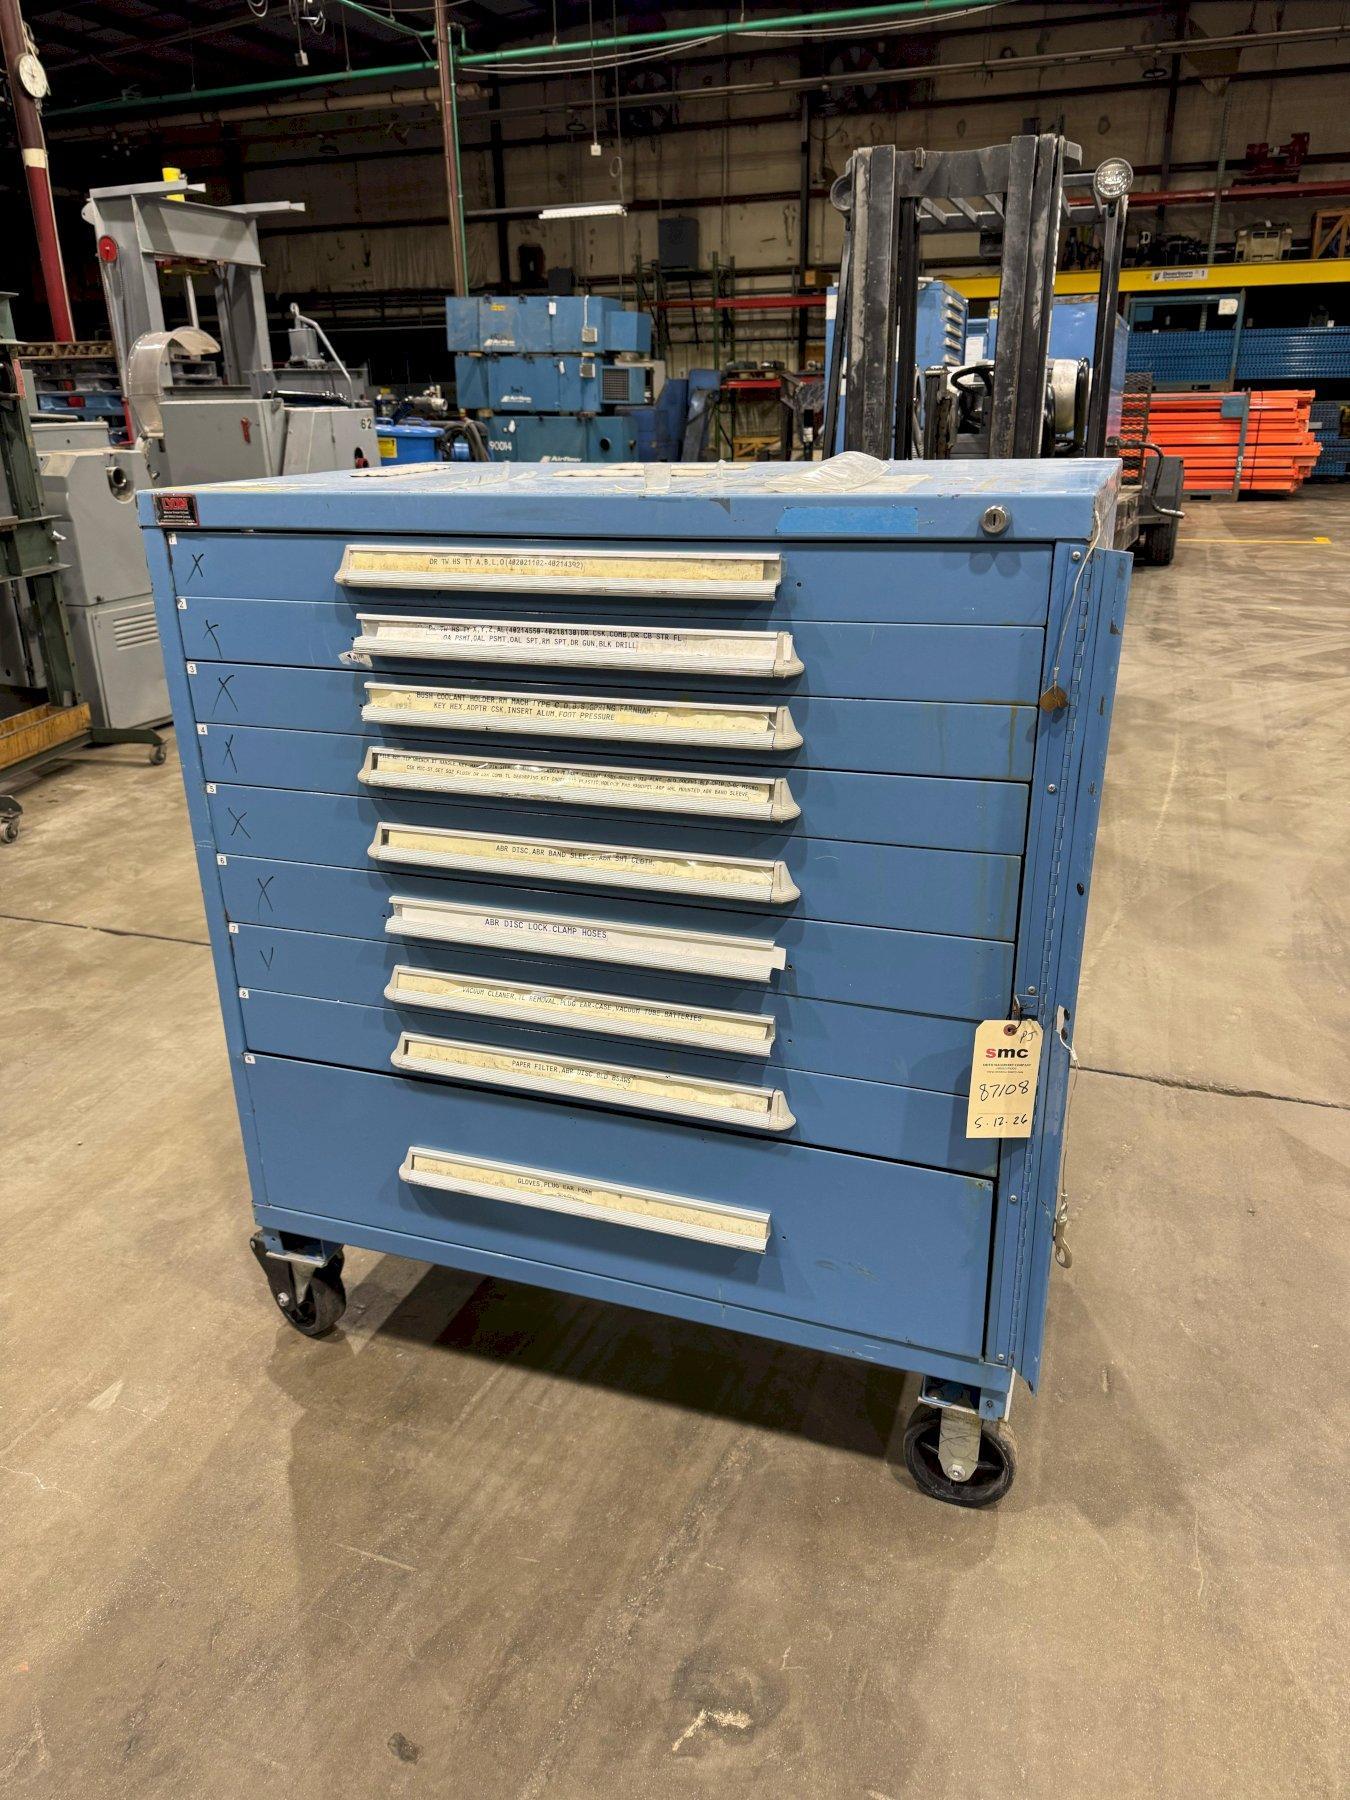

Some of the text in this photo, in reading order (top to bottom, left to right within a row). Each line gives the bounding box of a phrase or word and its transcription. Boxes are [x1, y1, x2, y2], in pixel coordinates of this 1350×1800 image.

[361, 418, 372, 430] 62
[437, 692, 466, 702] COOLANT
[580, 712, 616, 721] PRESSURE
[548, 850, 566, 858] BAND
[485, 918, 500, 926] ABR
[504, 920, 524, 929] DISC
[582, 928, 607, 939] HOSES
[462, 986, 485, 996] VACUUM
[986, 1048, 1029, 1058] smc
[512, 1060, 531, 1069] PAPER
[980, 1080, 1030, 1102] 87108
